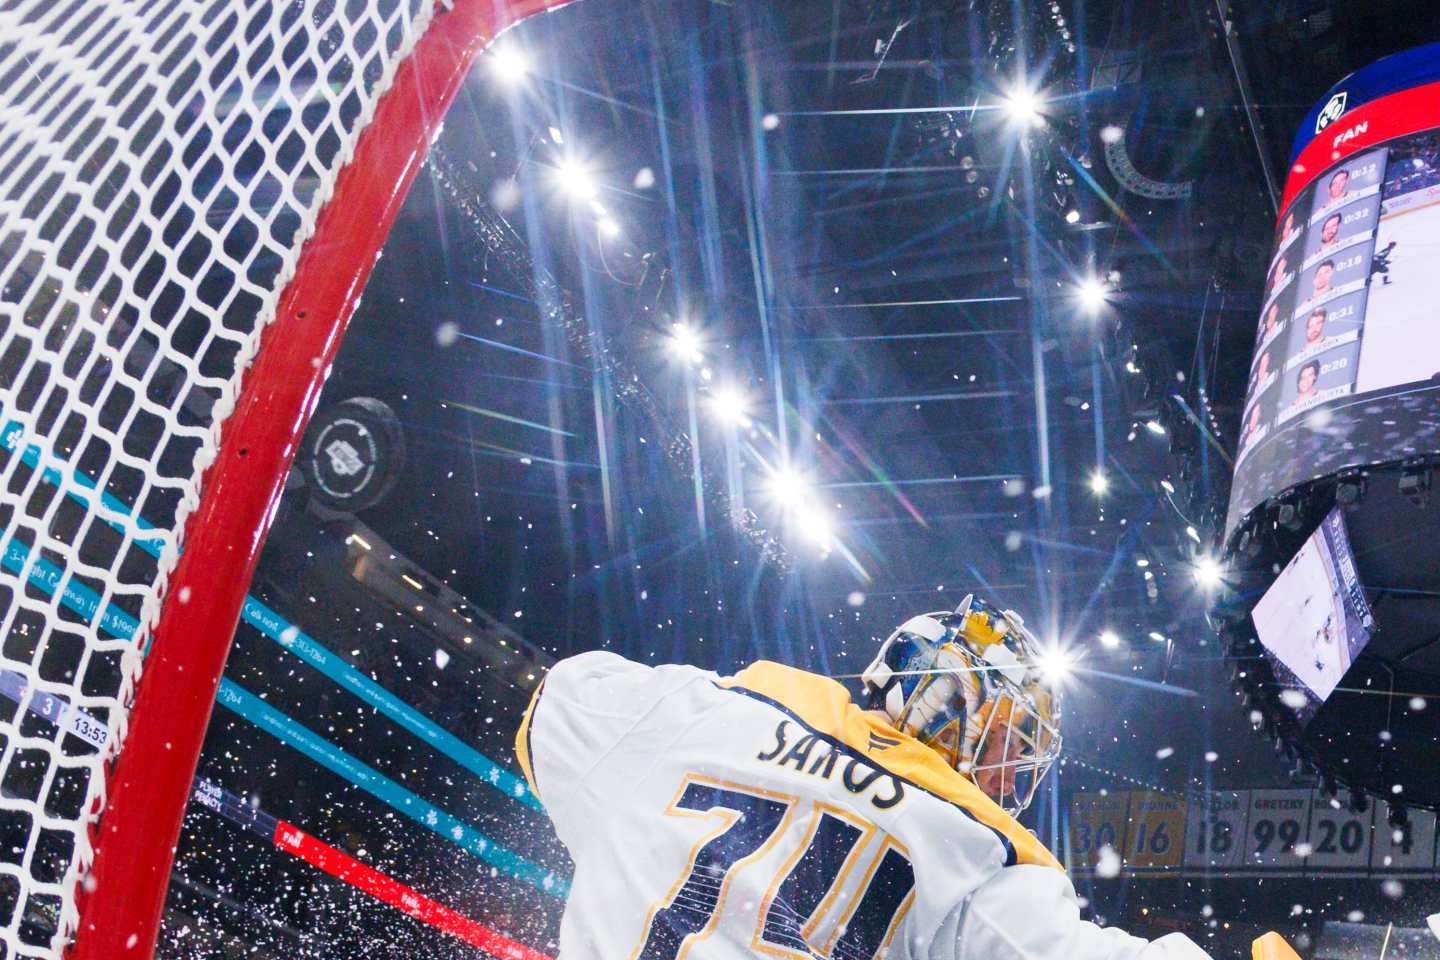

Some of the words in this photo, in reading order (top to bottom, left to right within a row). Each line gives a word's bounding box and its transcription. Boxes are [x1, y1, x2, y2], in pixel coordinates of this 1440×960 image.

[1332, 121, 1369, 148] FAN
[1352, 164, 1376, 179] 0:12
[1344, 207, 1368, 224] 0:32
[1329, 305, 1354, 321] 0:31
[1320, 357, 1347, 374] 0:20
[41, 697, 53, 715] 3
[74, 718, 108, 744] 13:53
[1132, 819, 1170, 854] 16
[1254, 818, 1299, 854] 99
[1316, 819, 1364, 855] 20
